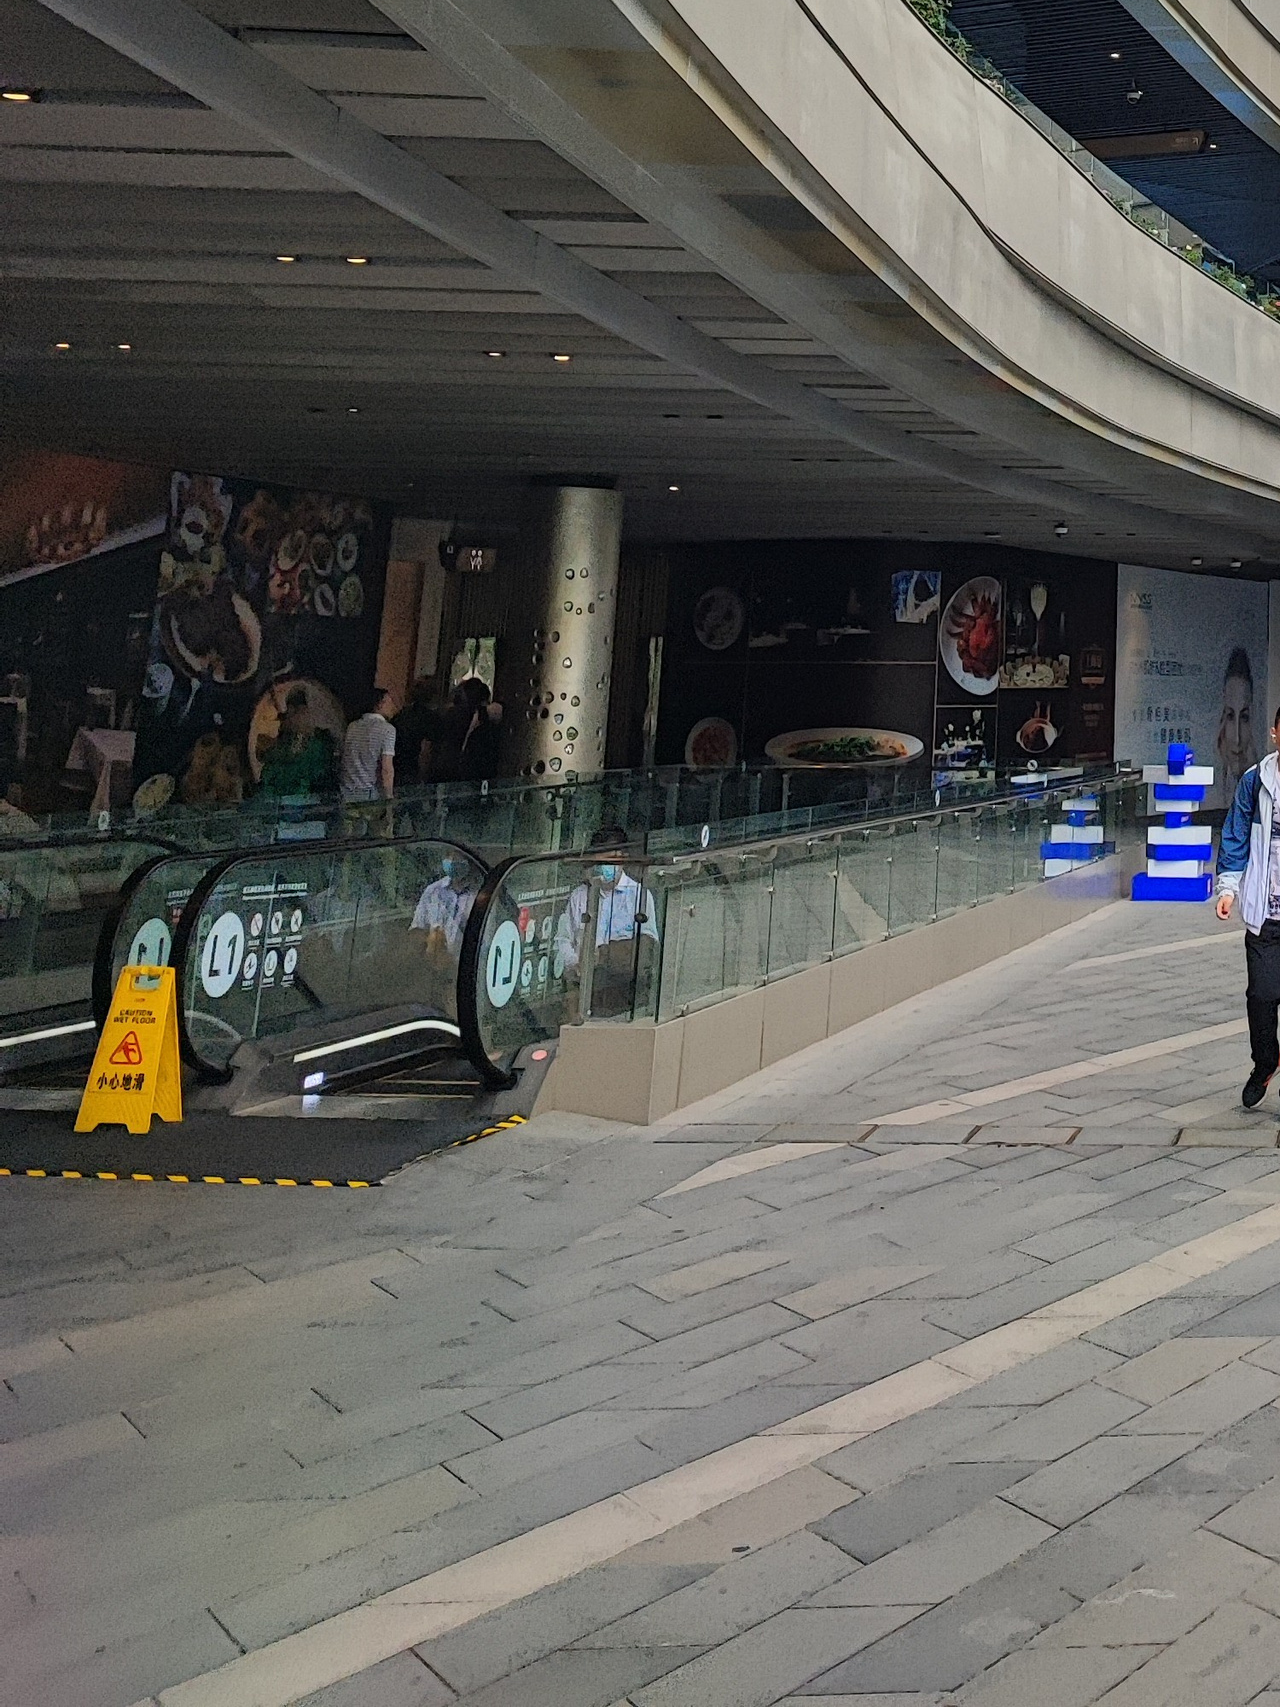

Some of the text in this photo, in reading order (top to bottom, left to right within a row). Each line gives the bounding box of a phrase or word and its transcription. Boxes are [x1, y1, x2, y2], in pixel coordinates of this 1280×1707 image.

[207, 933, 239, 978] L1
[119, 1009, 153, 1017] CAUTION
[113, 1016, 156, 1025] WET FLOOR
[96, 1072, 145, 1091] 小心地滑
